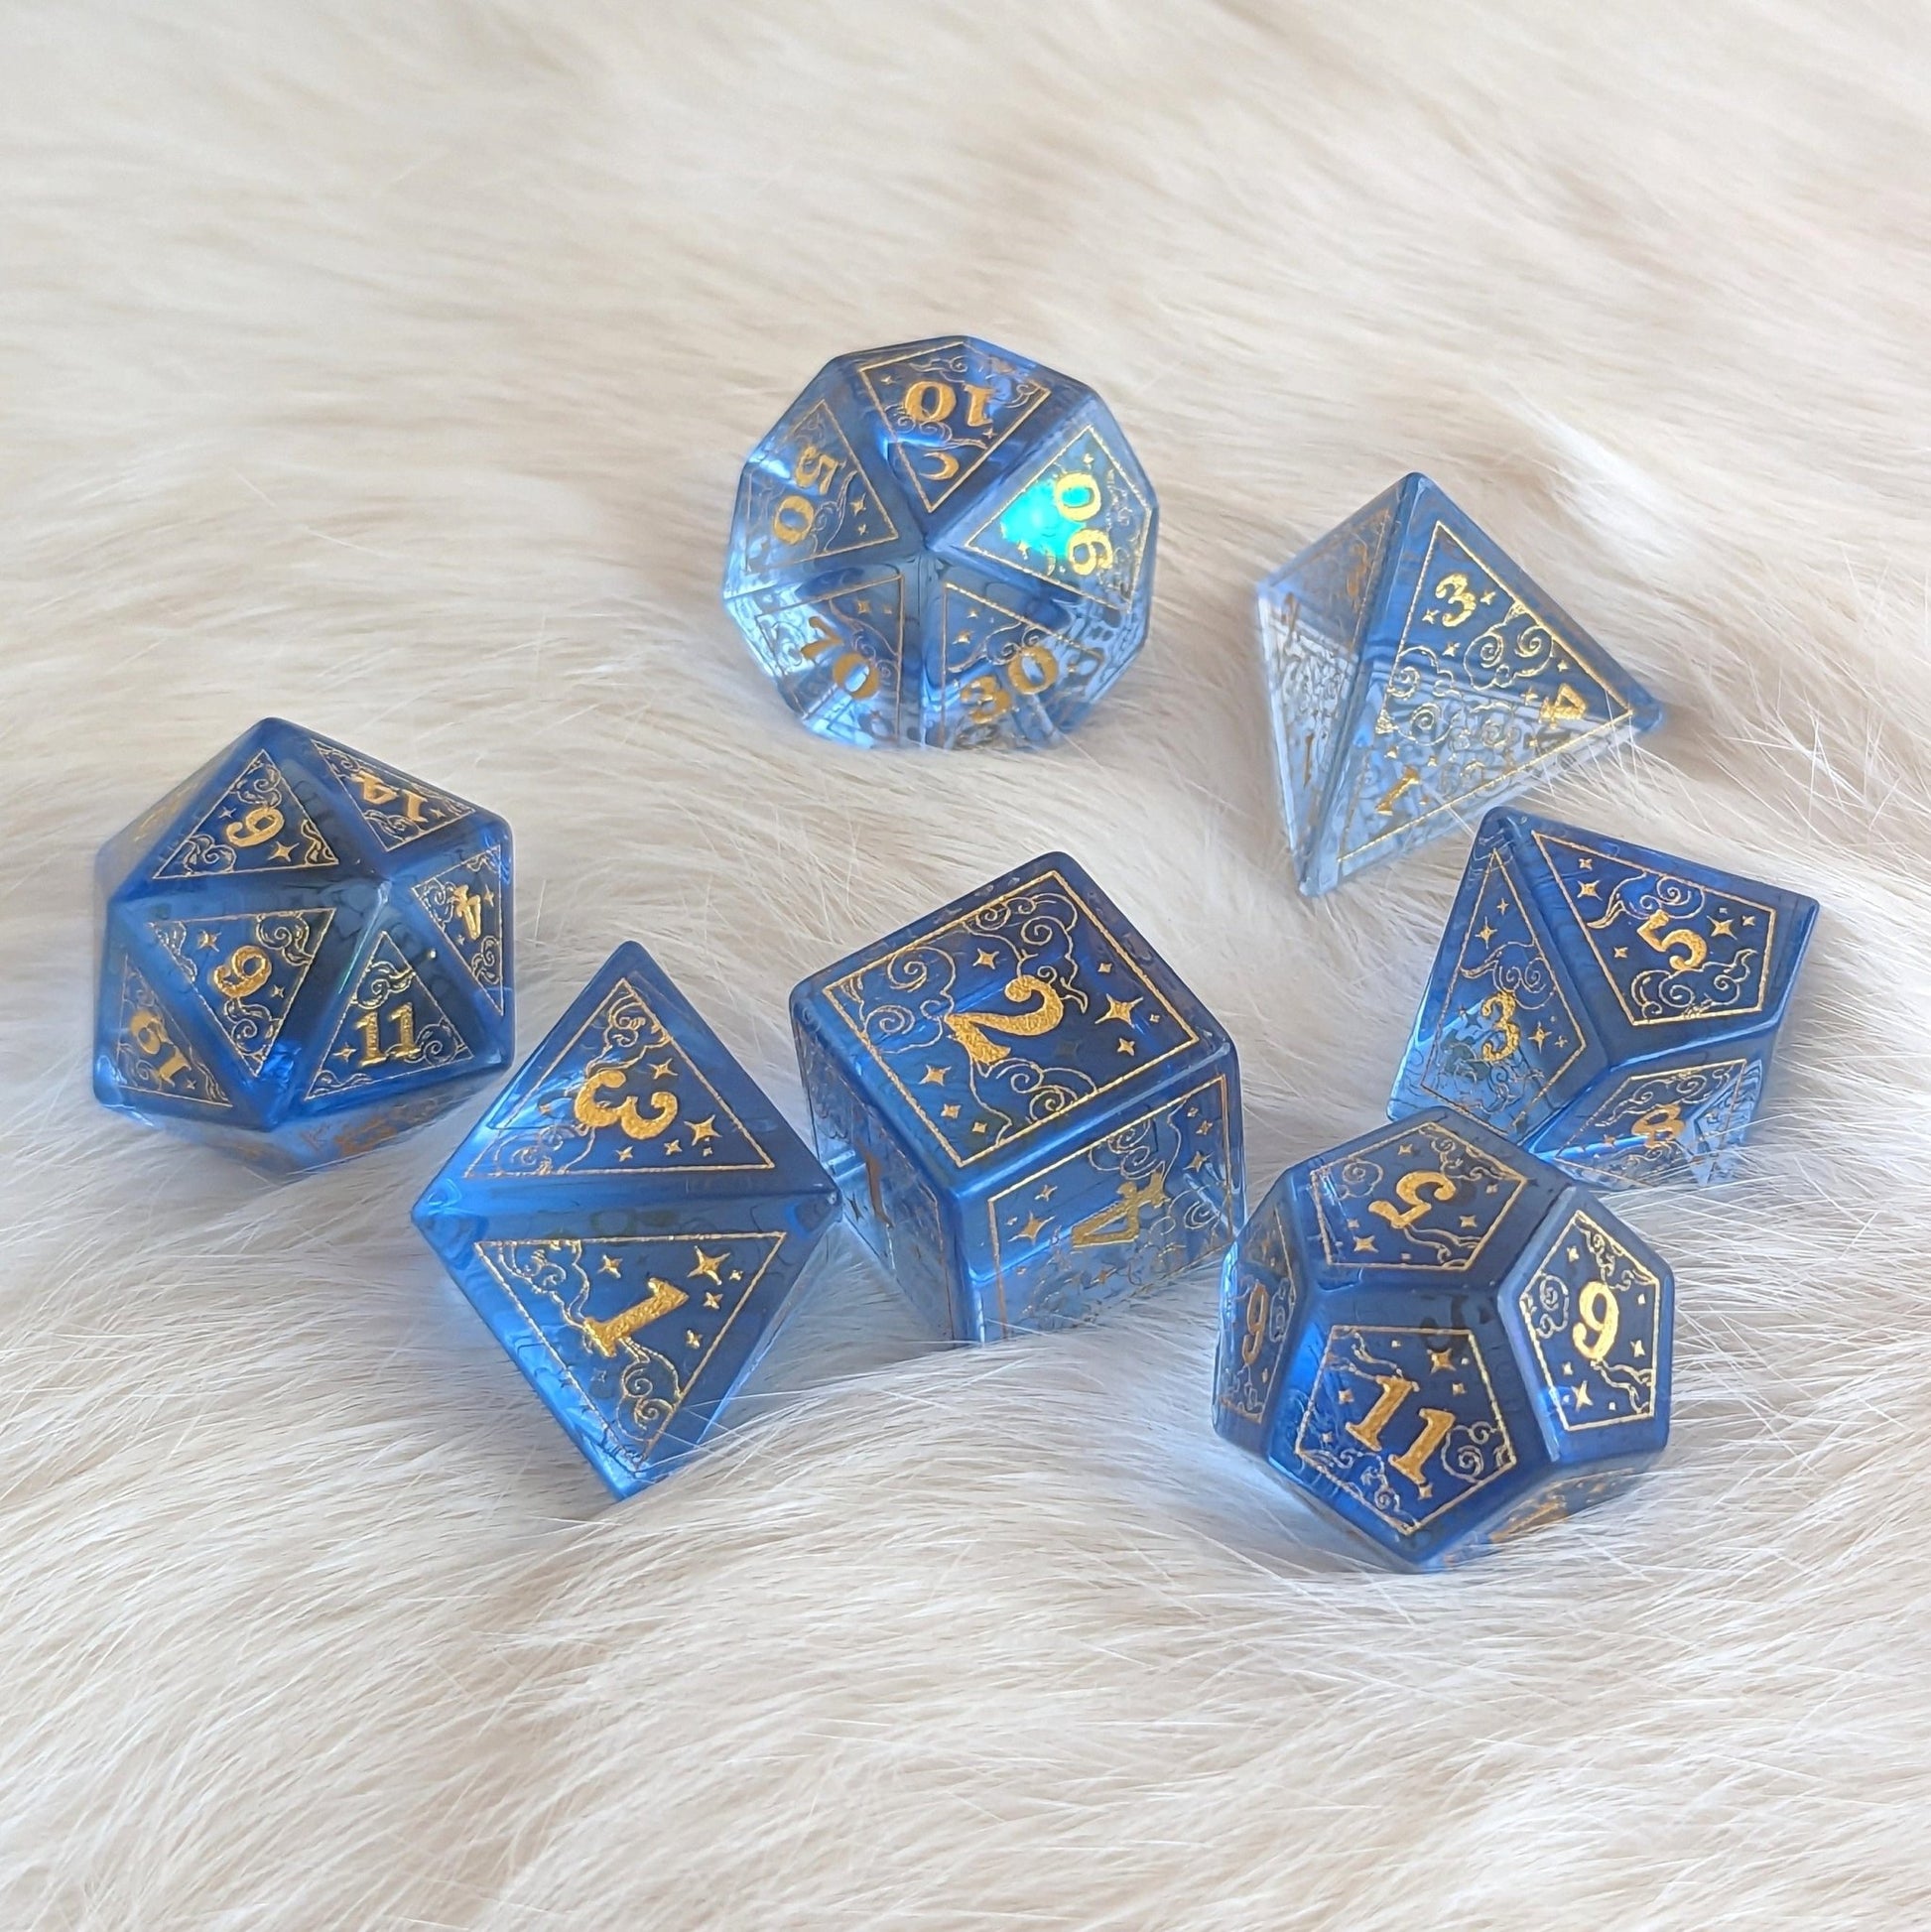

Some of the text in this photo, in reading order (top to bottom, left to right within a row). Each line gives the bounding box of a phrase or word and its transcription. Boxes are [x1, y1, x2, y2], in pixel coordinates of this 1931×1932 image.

[903, 379, 995, 428] 10
[772, 445, 839, 546] 50
[1435, 573, 1478, 628] 3
[800, 615, 880, 701] 70
[960, 646, 1058, 724] 30
[1538, 682, 1588, 730] 4
[349, 772, 429, 824] 14
[1374, 765, 1420, 816] 1
[452, 883, 482, 942] 4
[1636, 908, 1709, 971] 5
[212, 944, 273, 1000] 9
[354, 1002, 422, 1069] 11
[946, 974, 1064, 1066] 2
[1480, 990, 1521, 1063] 3
[574, 1068, 679, 1141] 3
[1071, 1169, 1171, 1248] 4
[1368, 1170, 1457, 1230] 5
[582, 1276, 690, 1359] 1
[1345, 1373, 1457, 1486] 11
